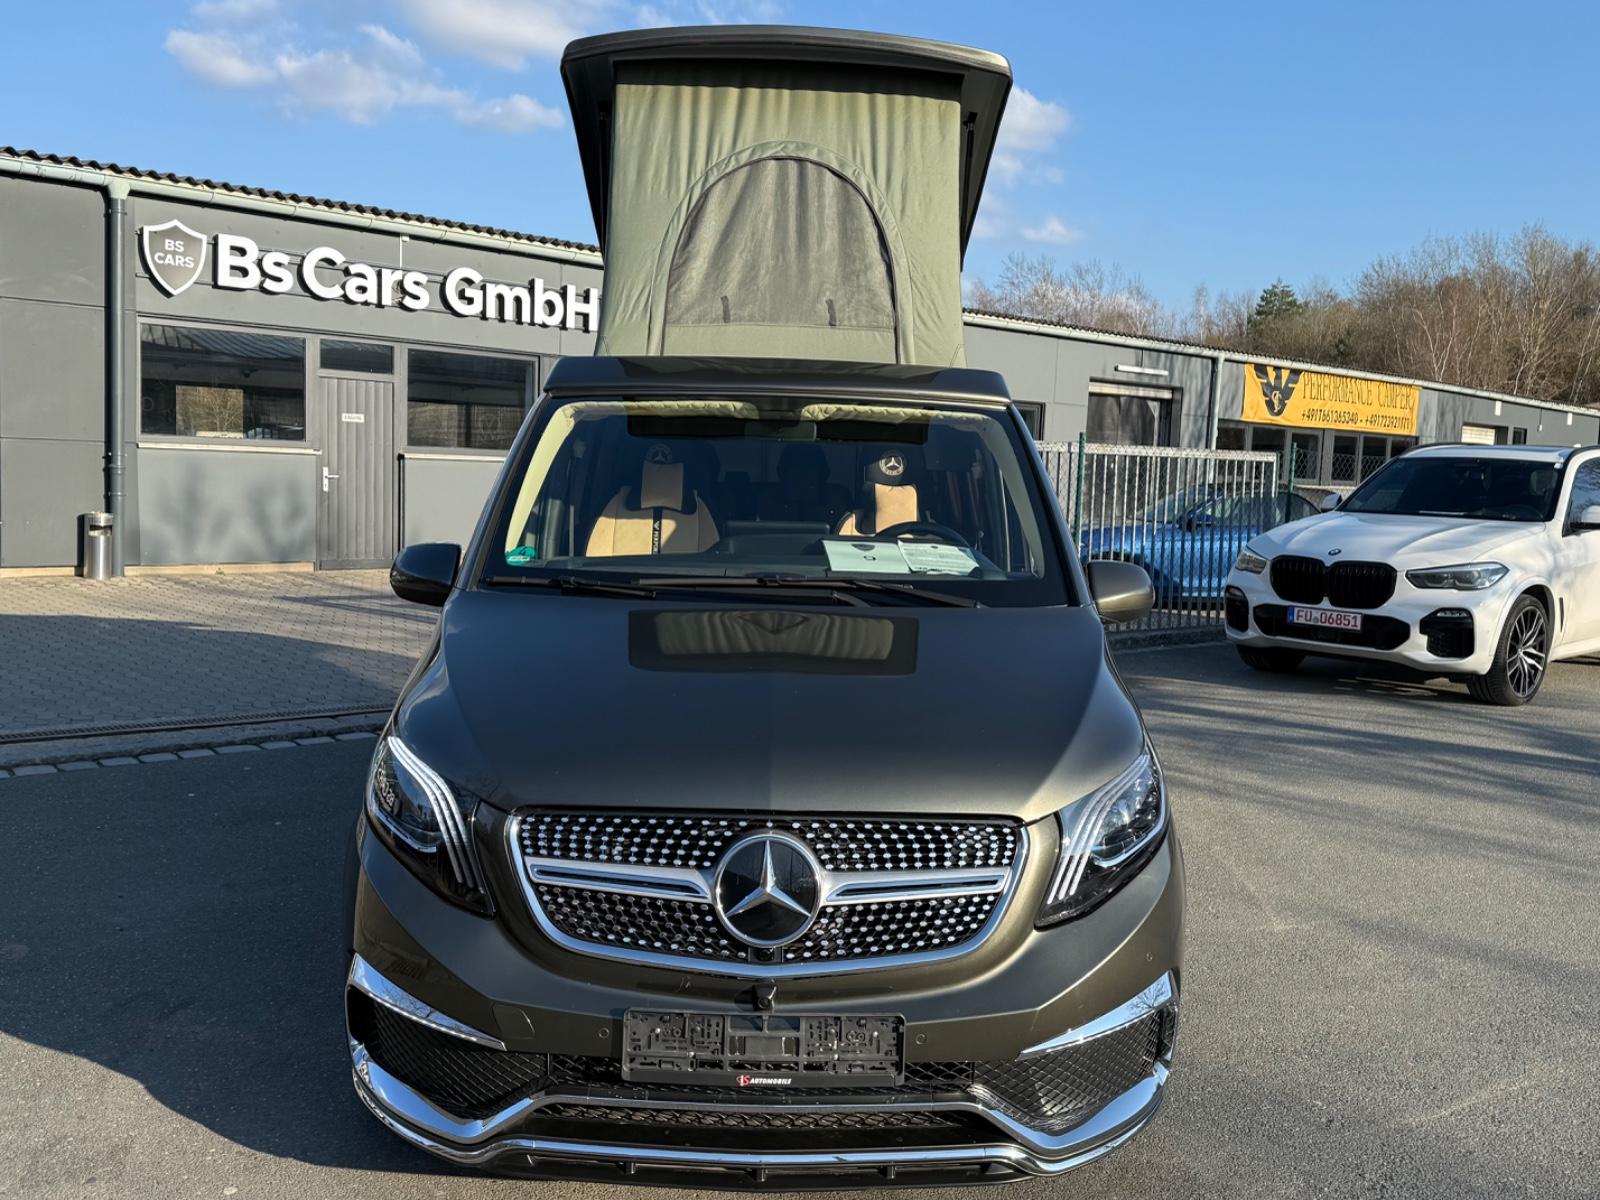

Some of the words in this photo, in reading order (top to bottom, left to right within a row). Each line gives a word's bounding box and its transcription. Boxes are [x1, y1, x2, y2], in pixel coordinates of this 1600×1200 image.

[164, 238, 185, 253] BS
[154, 252, 195, 268] CARS
[445, 267, 600, 331] GmbH
[1319, 611, 1359, 628] 06851
